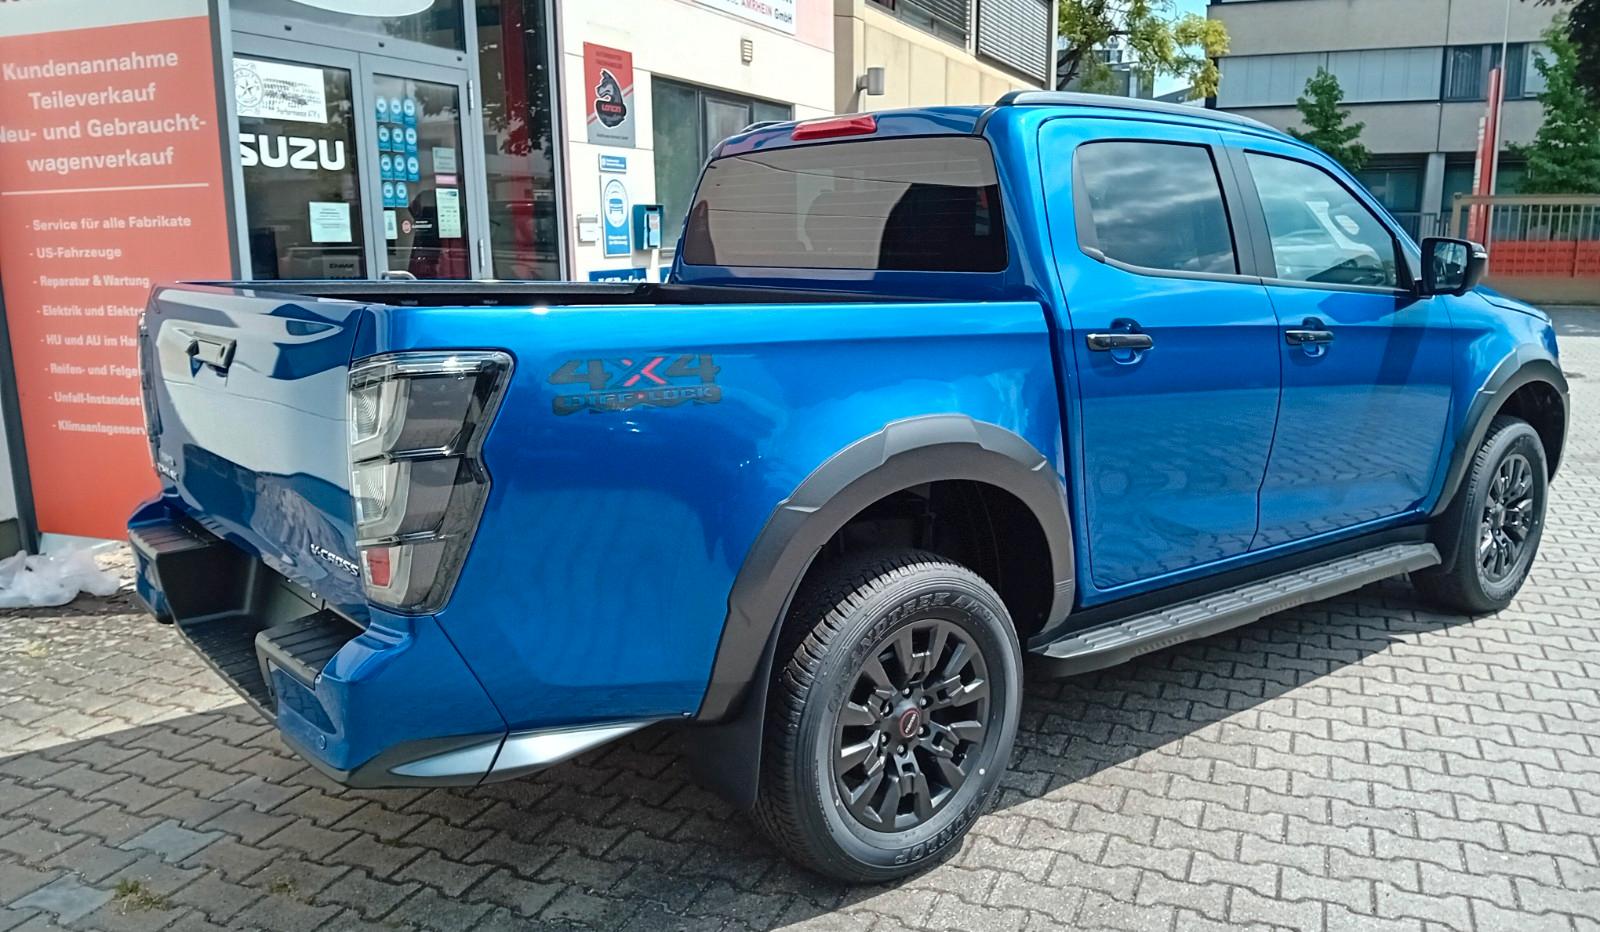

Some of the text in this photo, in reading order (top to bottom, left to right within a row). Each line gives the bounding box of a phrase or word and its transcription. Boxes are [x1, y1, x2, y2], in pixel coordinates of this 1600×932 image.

[774, 8, 793, 24] GmbH
[3, 52, 178, 81] Kundenannahme
[28, 83, 156, 110] Teileverkauf
[43, 121, 81, 141] und
[87, 114, 206, 138] Gebraucht-
[26, 146, 174, 175] wagenverkauf
[33, 215, 192, 231] Service für alle Fabrikate
[36, 247, 122, 260] US-Fahrzeuge
[39, 275, 150, 288] Reparatur & Wartung
[42, 305, 81, 316] Elektrik
[84, 305, 104, 316] und
[46, 335, 62, 345] HU
[64, 335, 83, 346] und
[103, 336, 117, 346] im
[87, 364, 107, 375] und
